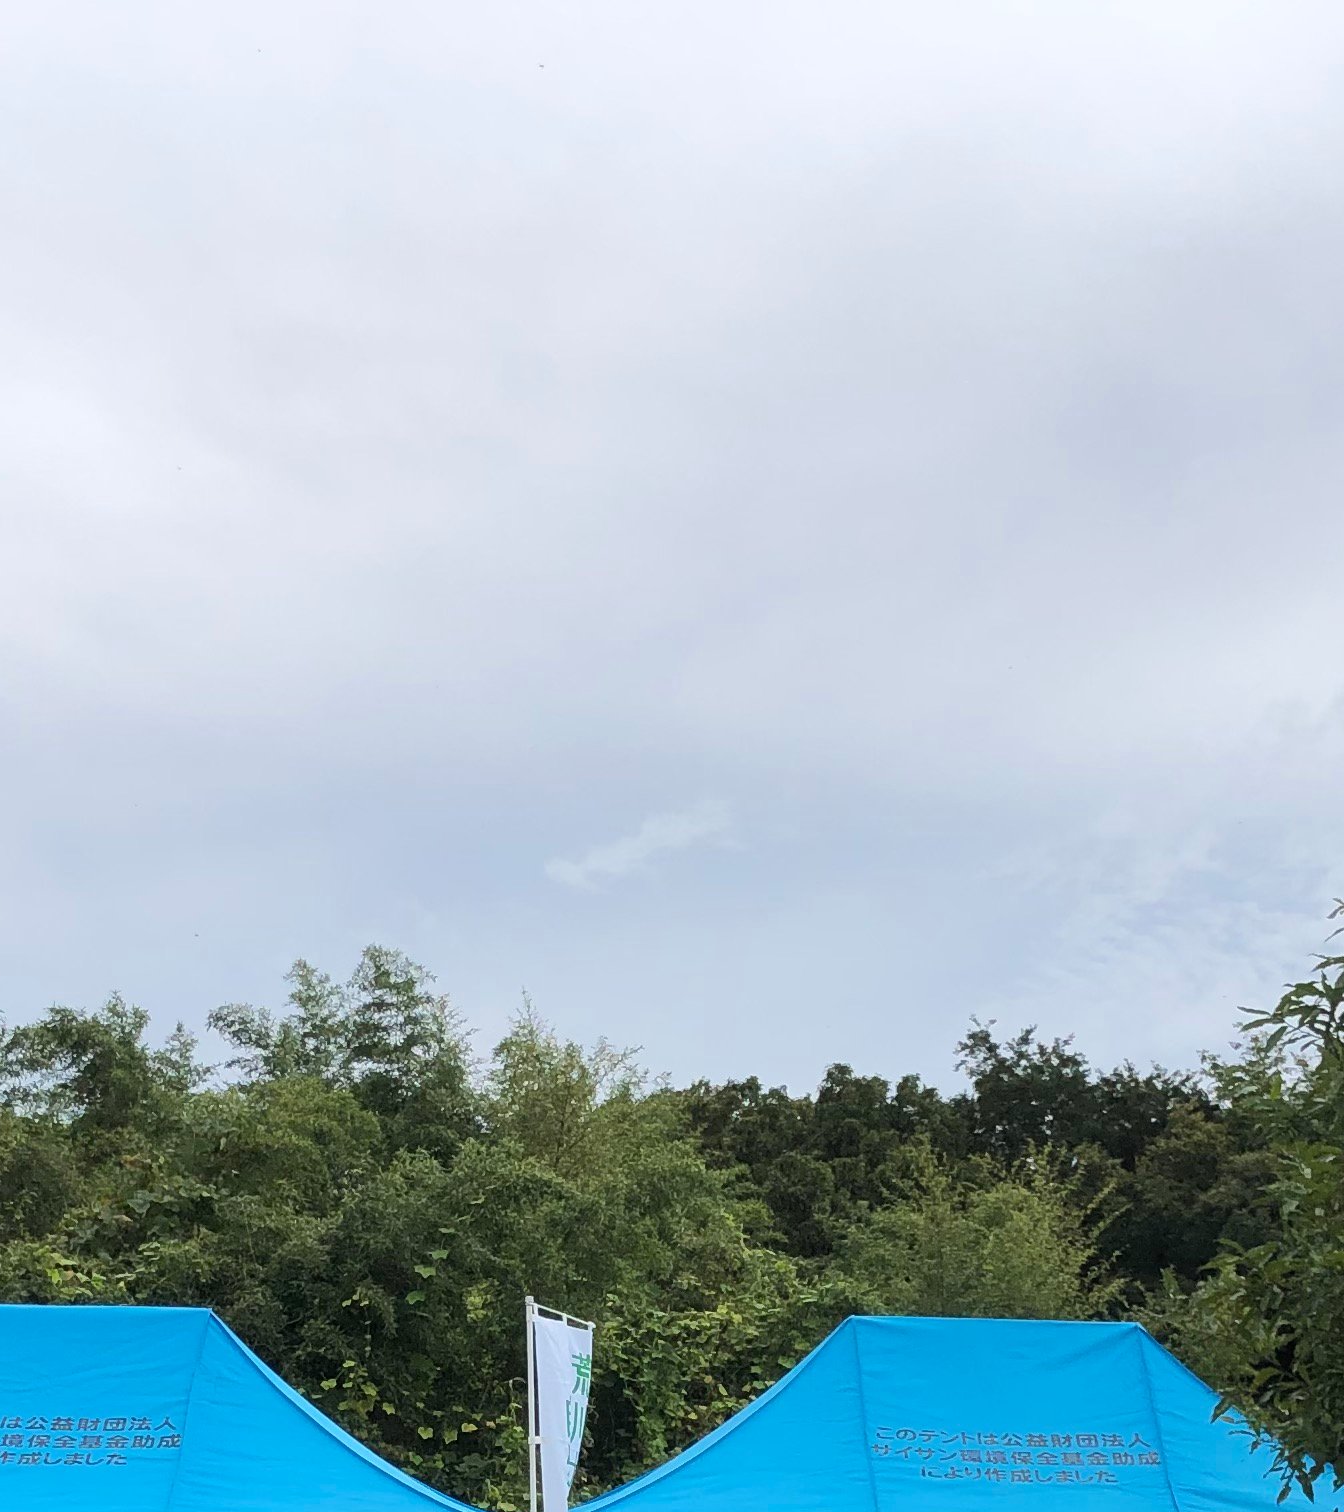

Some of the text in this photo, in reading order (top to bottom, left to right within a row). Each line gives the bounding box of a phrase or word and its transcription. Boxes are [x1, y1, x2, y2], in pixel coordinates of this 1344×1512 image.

[875, 1426, 1152, 1448] このテントは公益財団法人
[920, 1466, 1120, 1484] により作成しました
